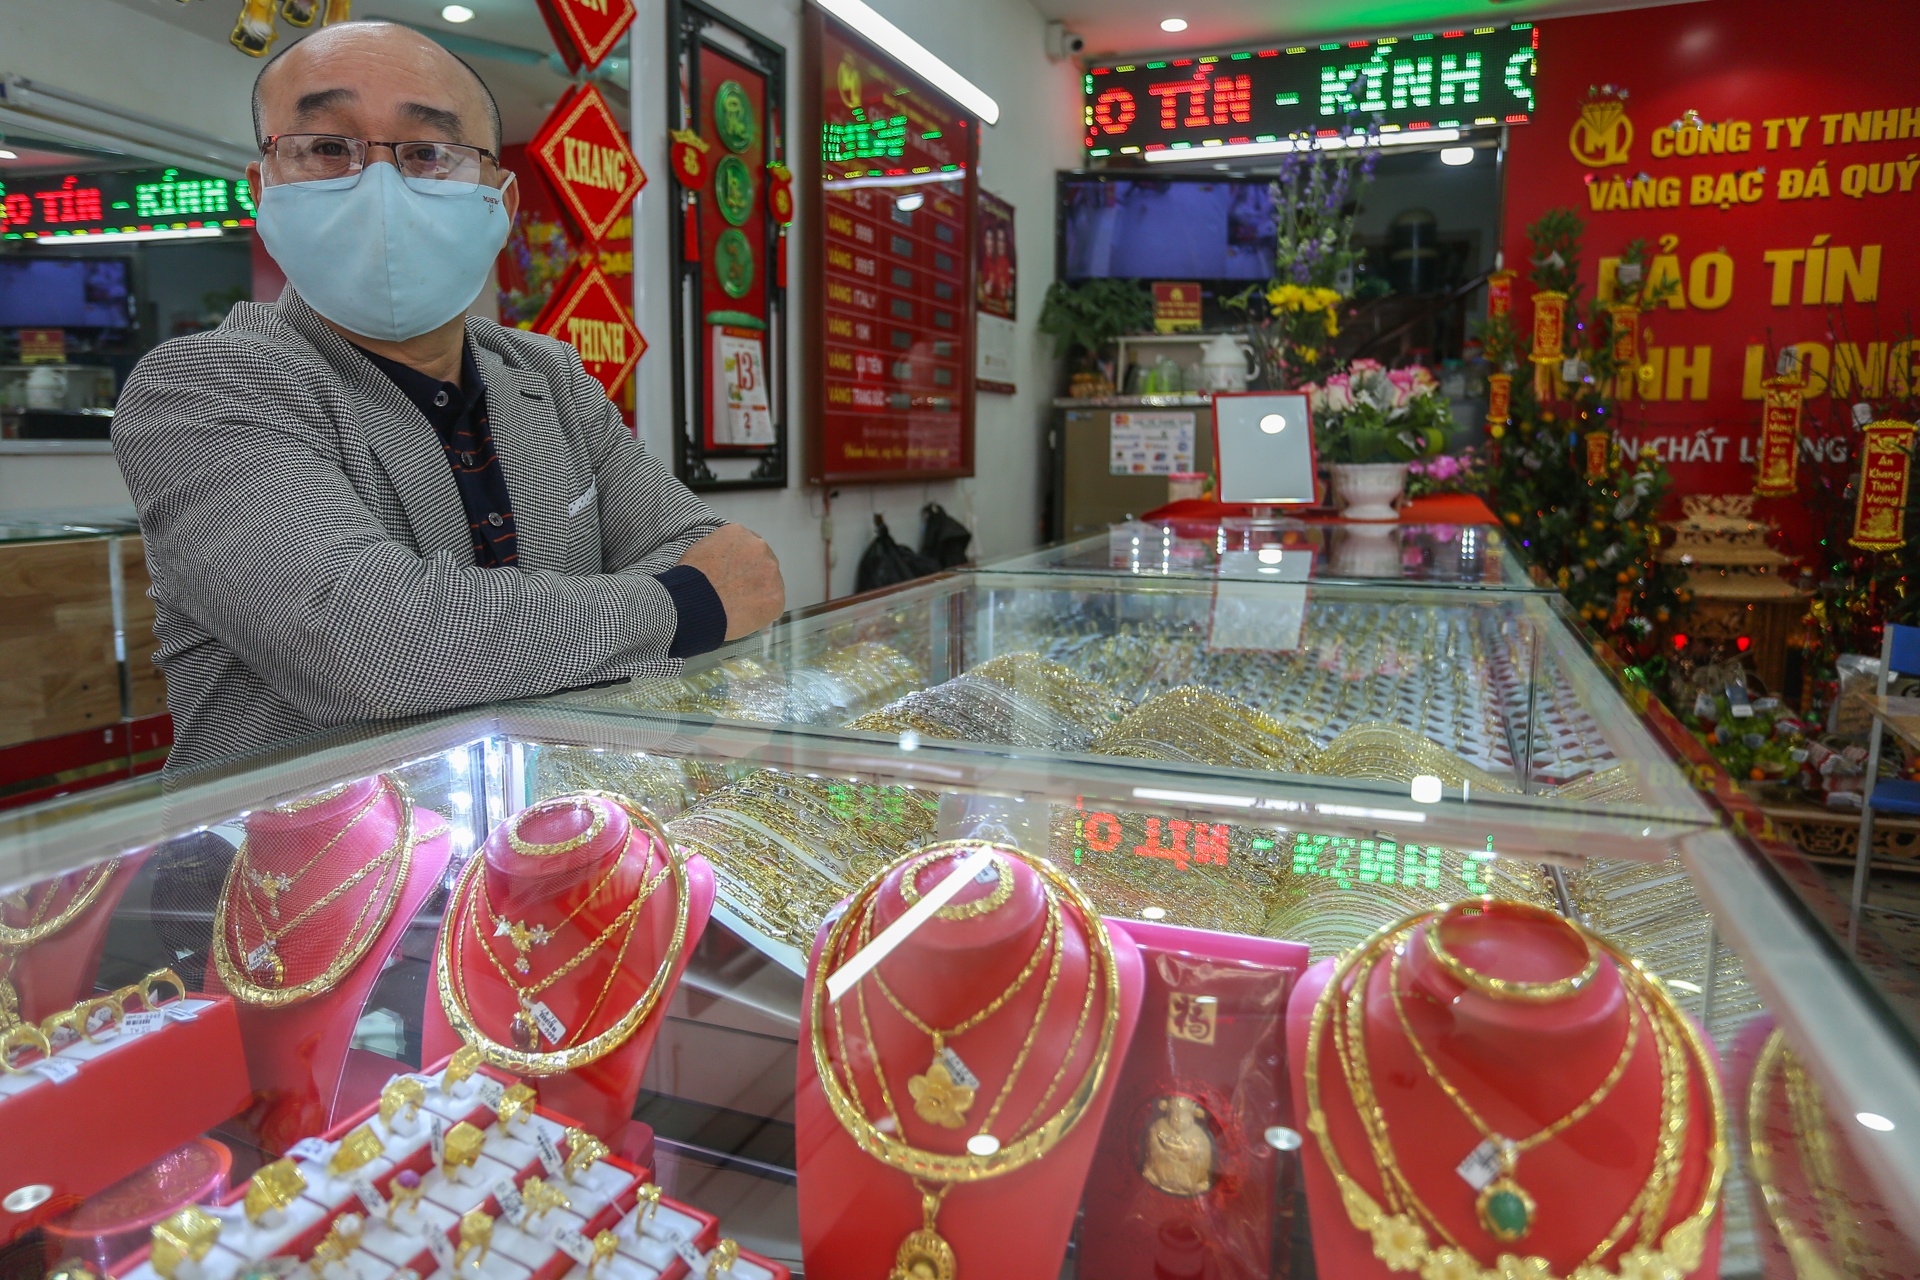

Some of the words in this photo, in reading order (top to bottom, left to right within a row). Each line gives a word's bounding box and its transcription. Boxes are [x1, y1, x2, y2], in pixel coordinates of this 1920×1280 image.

[1149, 64, 1251, 129] TÍN
[1320, 46, 1482, 115] KÍNH
[1762, 116, 1809, 151] TY
[1820, 107, 1920, 145] TNHH
[564, 137, 627, 193] KHANG
[1588, 174, 1681, 211] VÀNG
[1690, 172, 1764, 210] BẠC
[1778, 160, 1830, 200] ĐÁ
[1841, 154, 1920, 199] QUÝ
[35, 175, 102, 223] TÍN
[136, 168, 228, 217] KÍNH
[1764, 234, 1882, 306] TÍN
[568, 317, 625, 373] THỊNH
[734, 352, 754, 391] 13
[743, 412, 751, 429] 2
[1868, 468, 1902, 481] Khang
[1878, 455, 1894, 466] An
